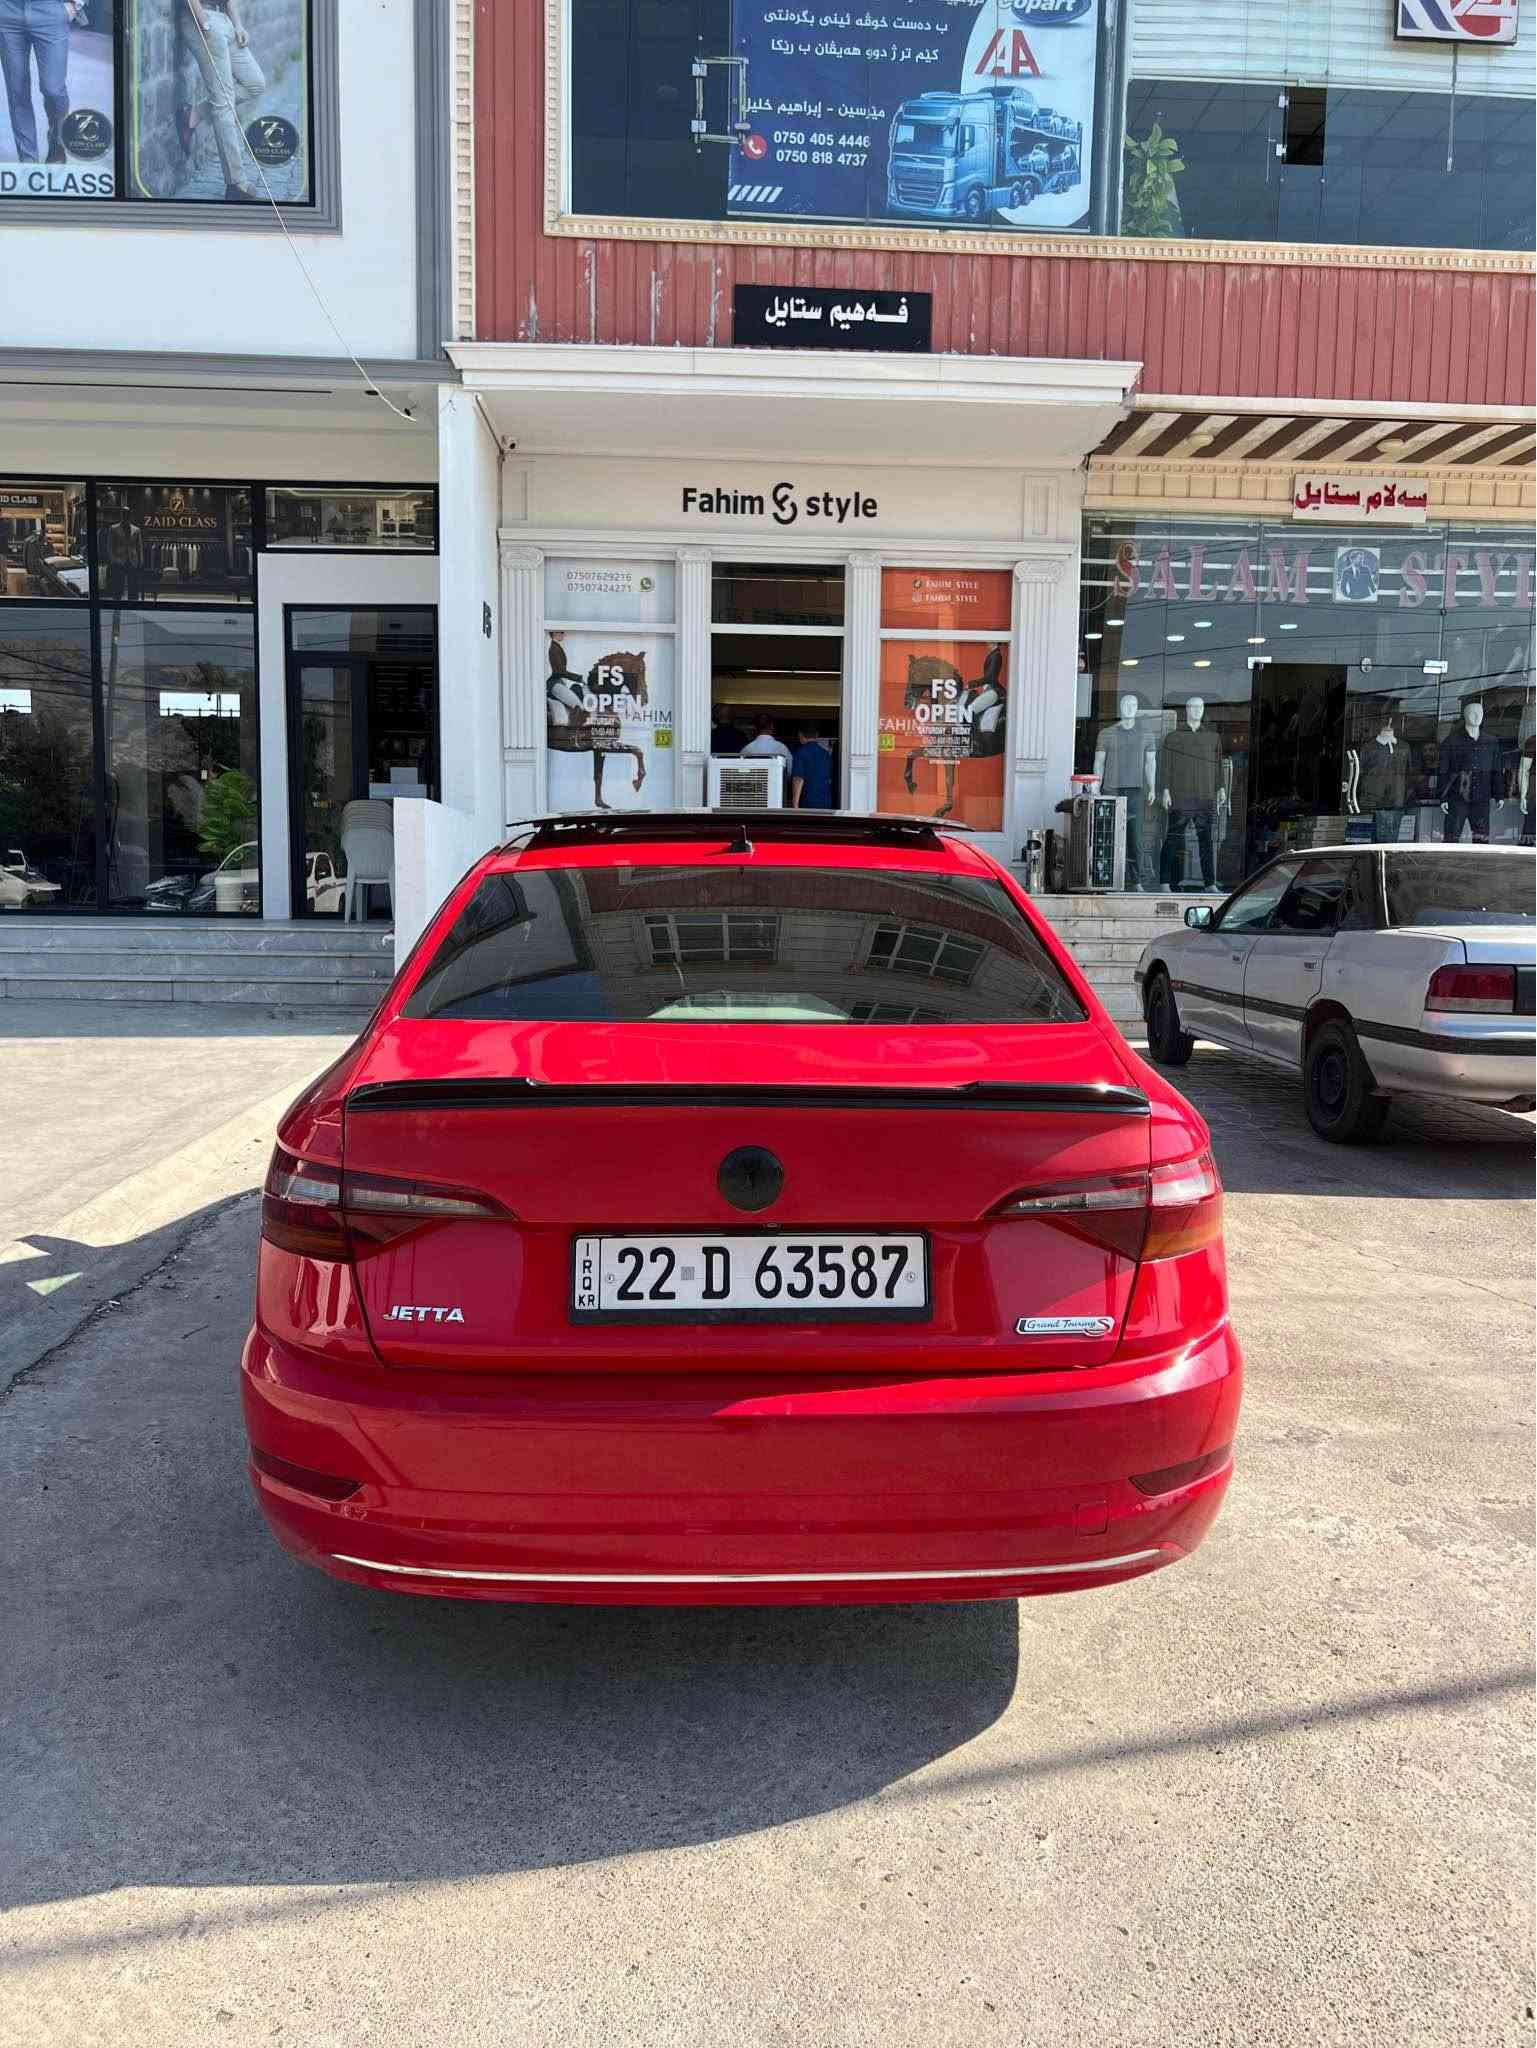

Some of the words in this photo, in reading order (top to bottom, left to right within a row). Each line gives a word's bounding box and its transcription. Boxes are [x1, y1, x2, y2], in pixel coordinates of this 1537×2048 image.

[773, 131, 805, 145] 0750
[809, 134, 834, 146] 405
[838, 135, 871, 148] 4446
[776, 151, 808, 163] 0750
[812, 152, 833, 164] 818
[837, 153, 867, 167] 4737
[28, 172, 114, 194] CLASS
[765, 296, 822, 327] ستایل
[682, 488, 764, 515] Fahim
[806, 492, 878, 523] style
[1295, 481, 1360, 510] ستایل
[144, 516, 176, 528] ZAID
[180, 516, 217, 529] CLASS
[1113, 543, 1312, 603] SALAM
[597, 665, 625, 686] FS
[932, 679, 957, 699] FS
[583, 693, 642, 713] OPEN
[915, 703, 973, 723] OPEN
[617, 1247, 676, 1301] 22
[702, 1246, 731, 1299] D
[755, 1245, 909, 1299] 63587
[579, 1294, 595, 1307] KR
[383, 1305, 464, 1323] JETTA
[1027, 1320, 1059, 1329] Grand
[1063, 1320, 1096, 1330] Touring
